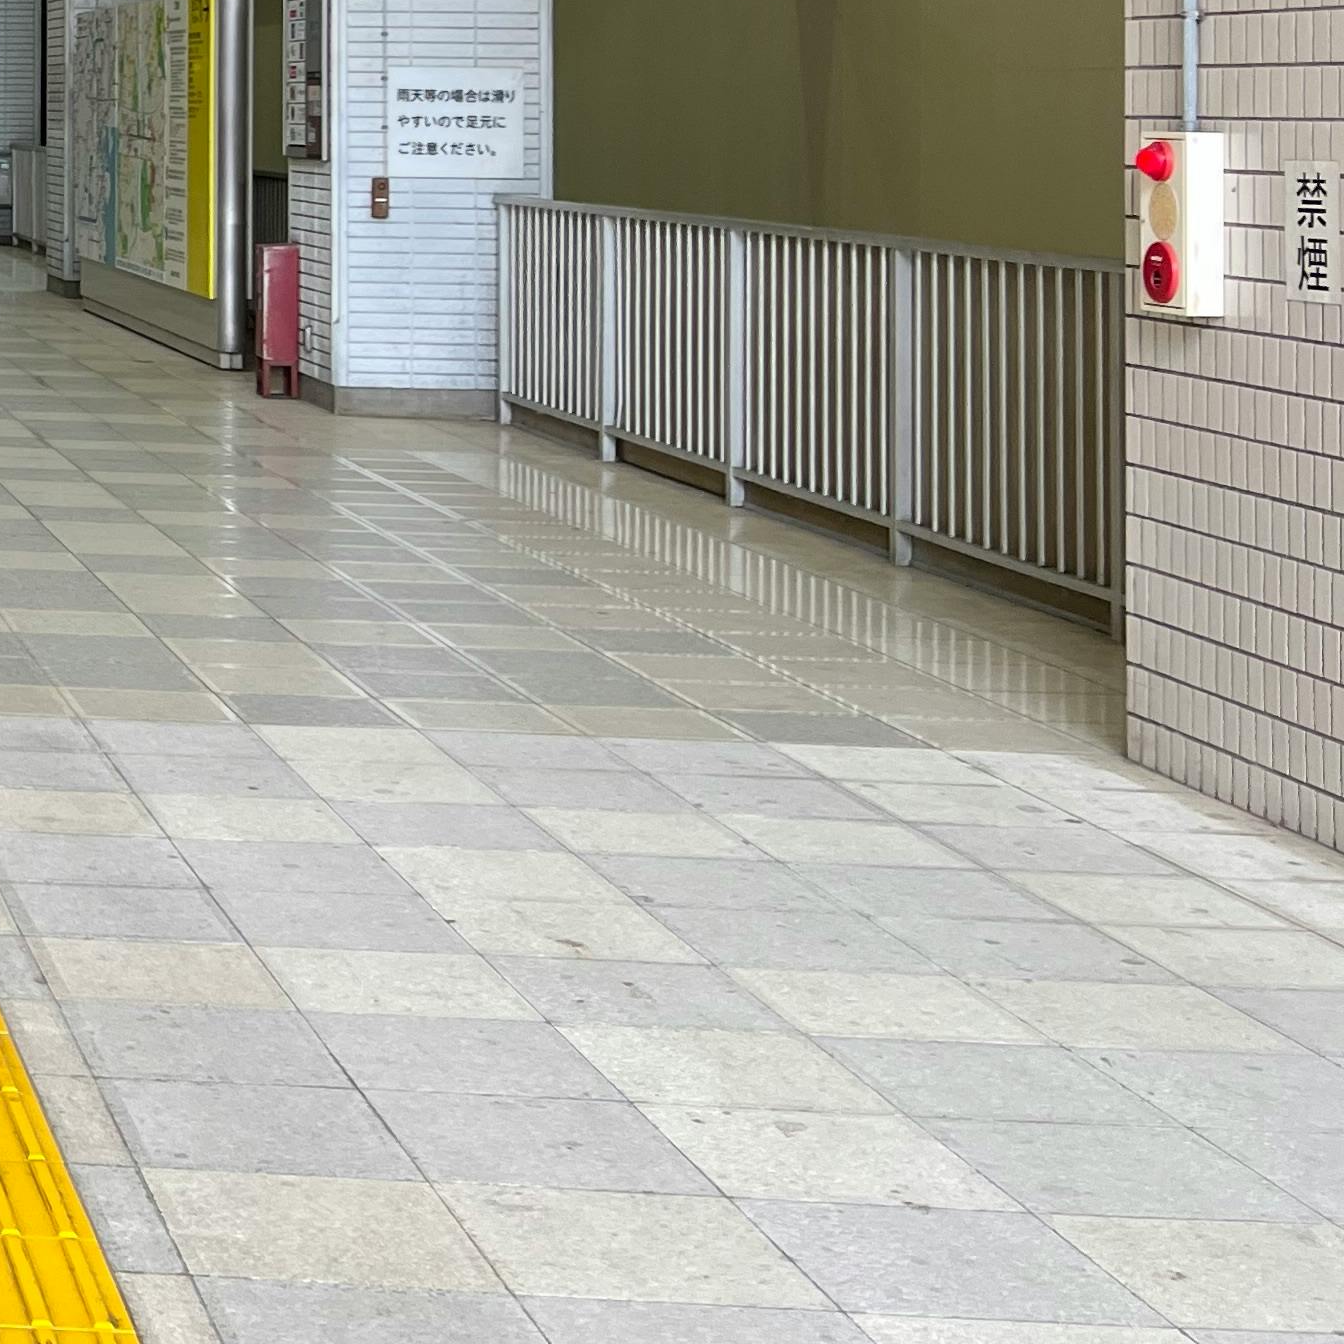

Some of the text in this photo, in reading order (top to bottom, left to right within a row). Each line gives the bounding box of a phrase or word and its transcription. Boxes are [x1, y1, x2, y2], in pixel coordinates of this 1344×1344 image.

[397, 88, 516, 103] 雨天等の場合は滑り
[397, 115, 507, 129] やすいので足元に
[398, 142, 496, 156] ご注意ください。
[1296, 172, 1330, 292] 禁煙
